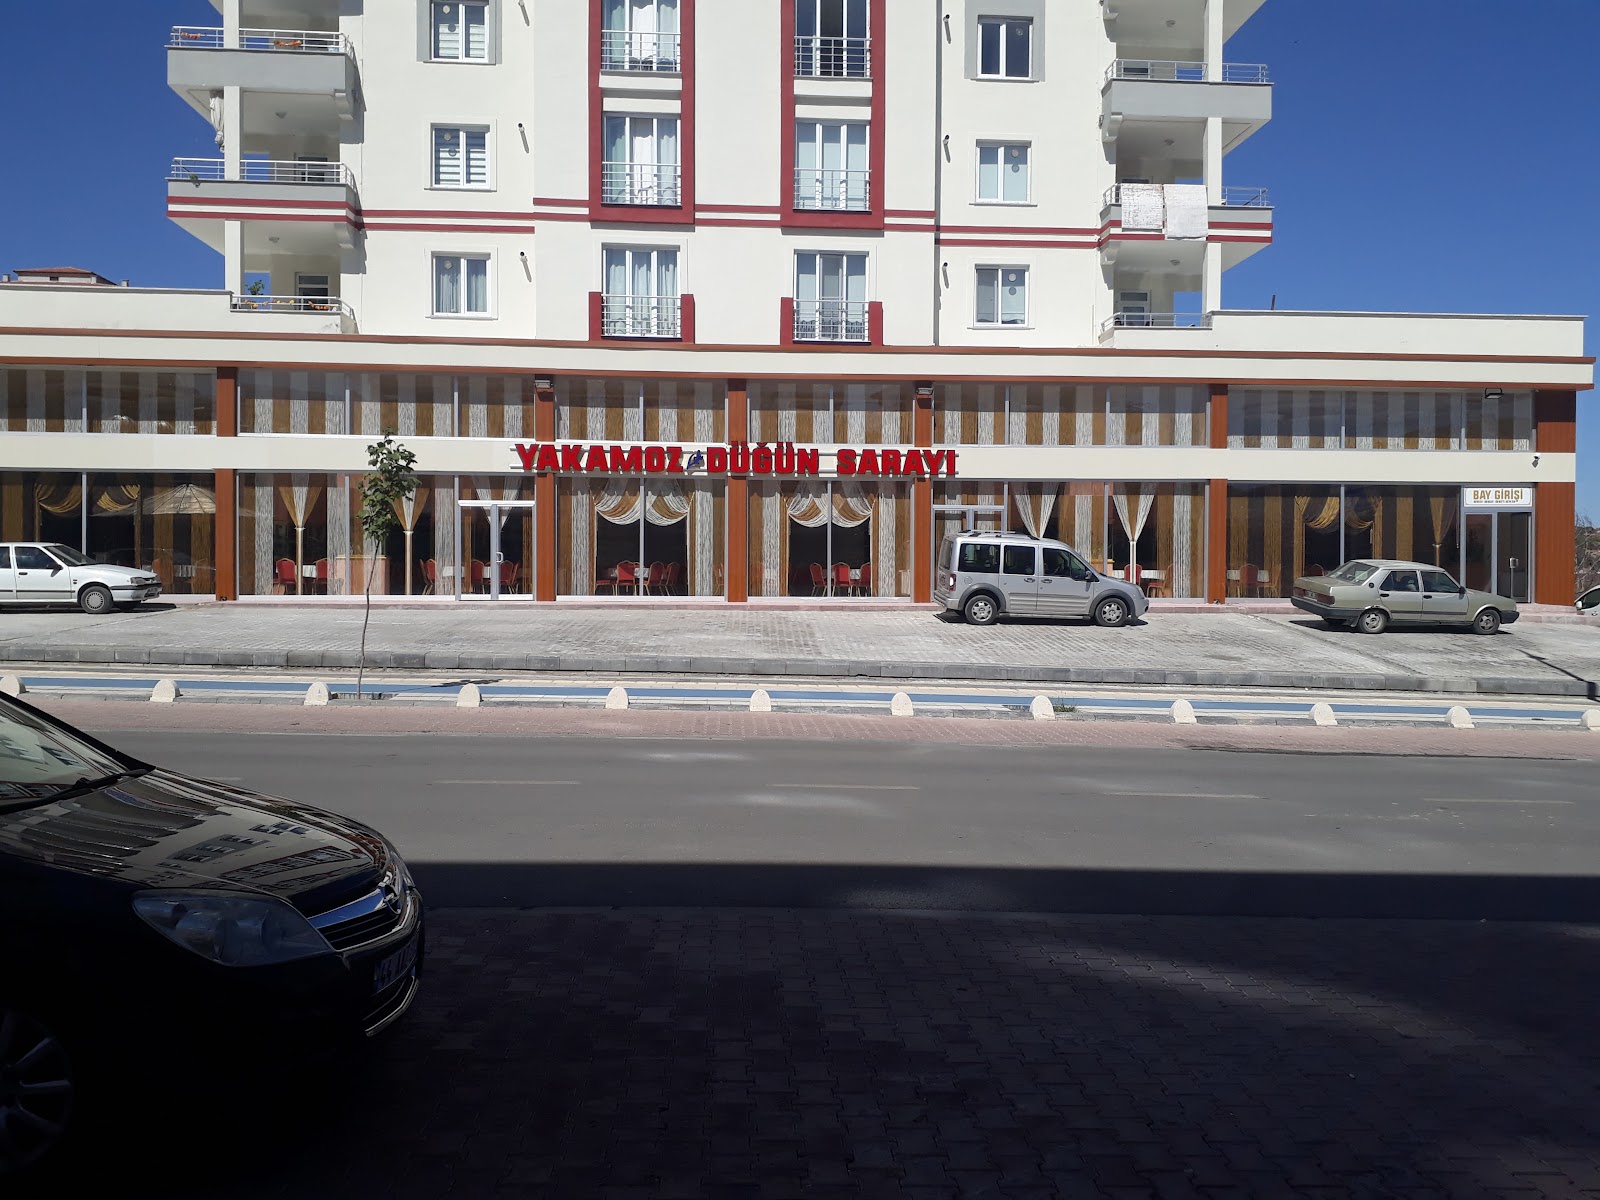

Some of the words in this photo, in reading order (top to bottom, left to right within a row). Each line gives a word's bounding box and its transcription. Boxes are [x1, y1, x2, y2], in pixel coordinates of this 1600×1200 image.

[515, 443, 684, 473] YAKAMOZ
[707, 440, 819, 475] DÜĞÜN
[836, 449, 956, 475] SARAYI
[1473, 489, 1491, 500] BAY
[1494, 488, 1523, 501] GİRİŞİ
